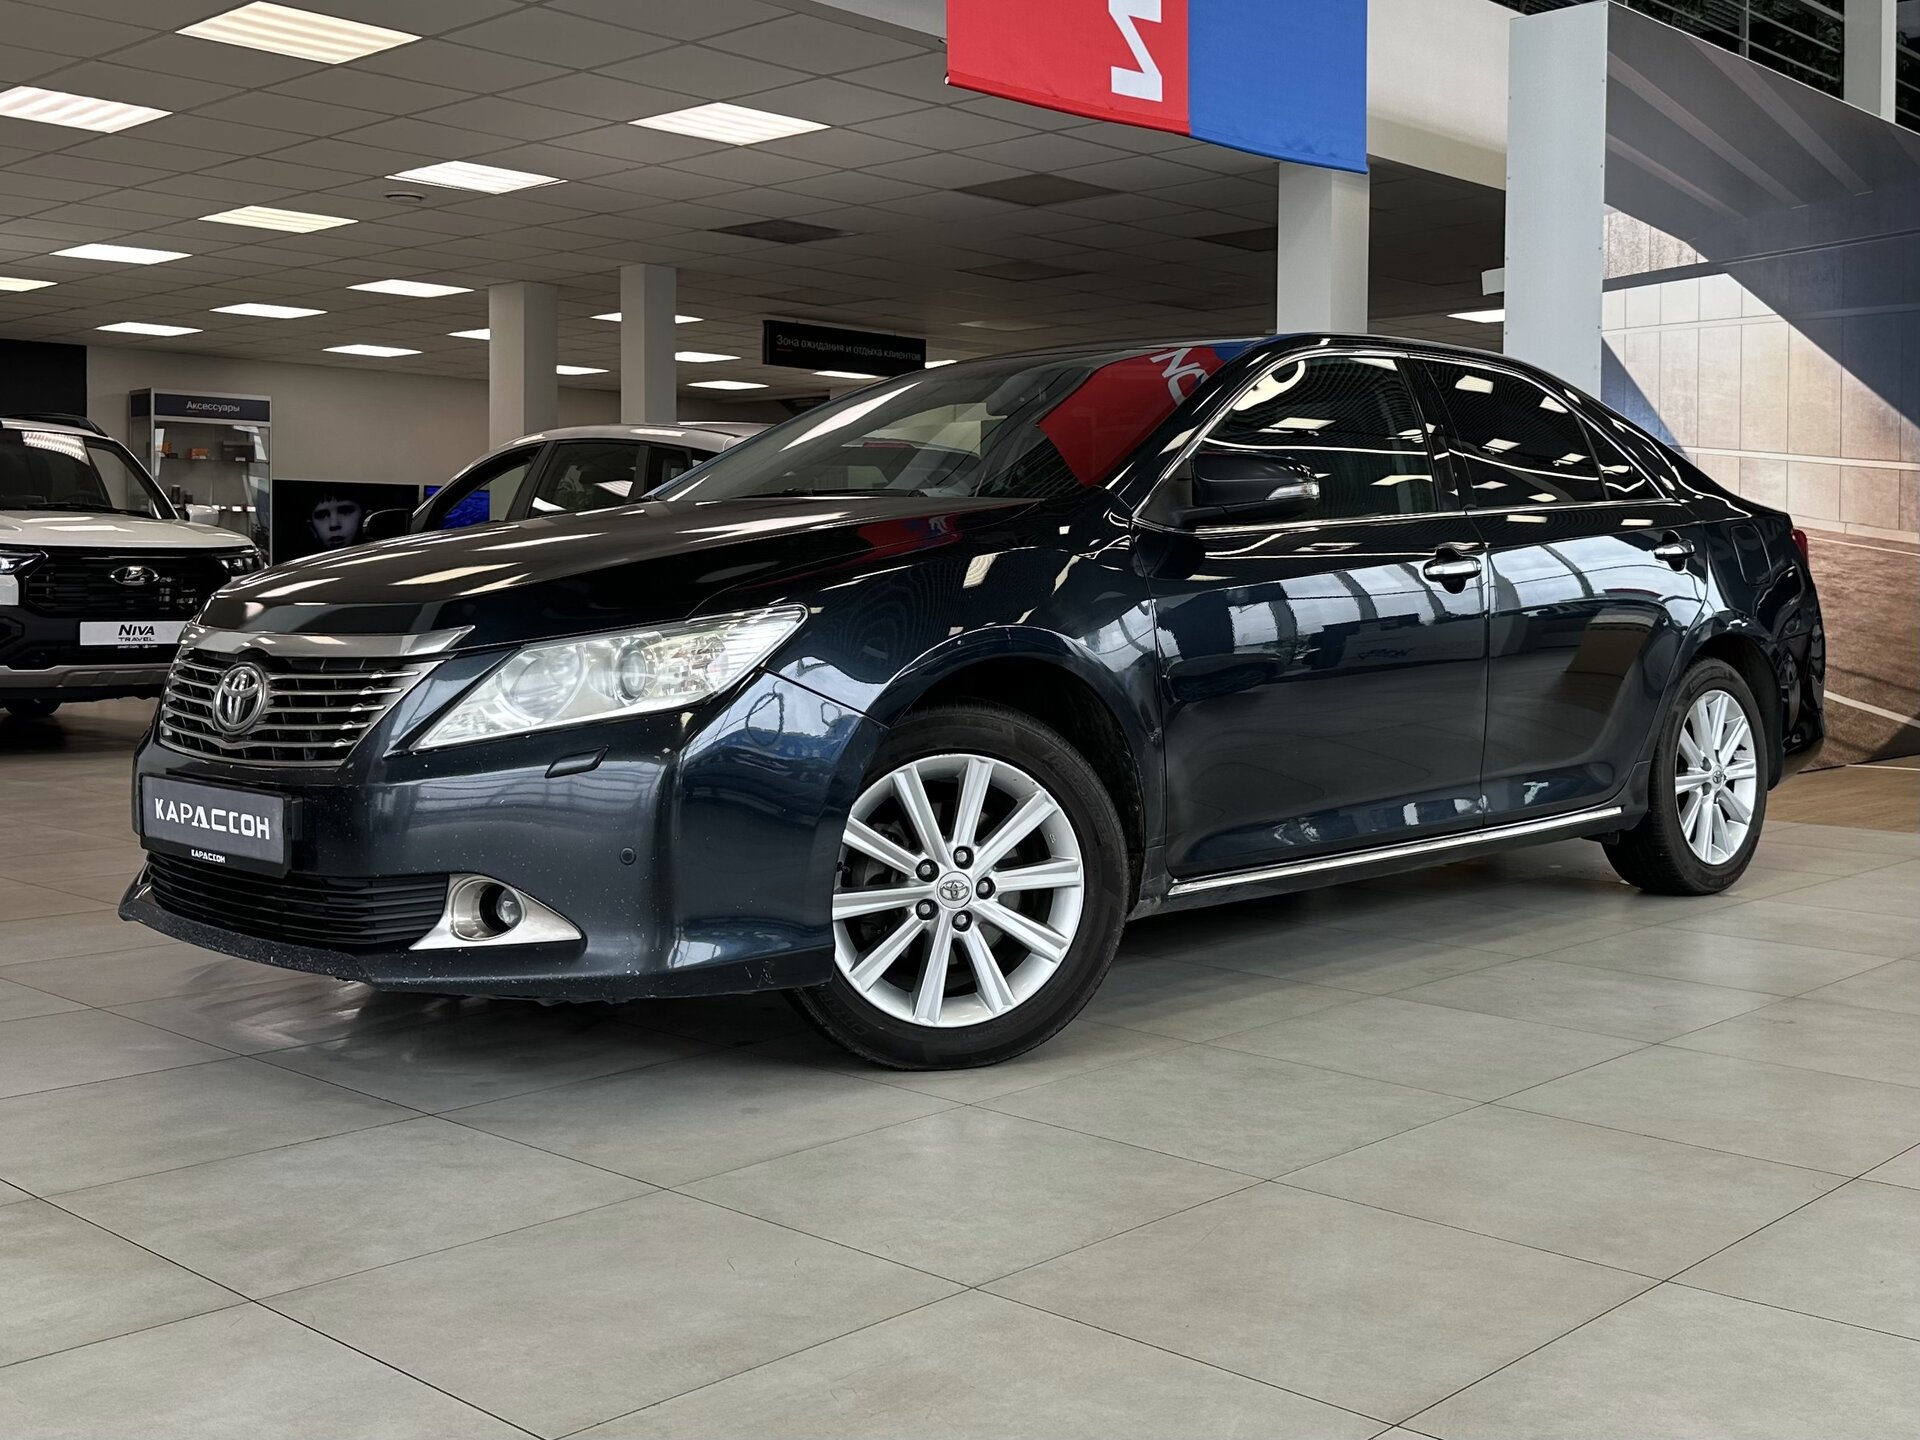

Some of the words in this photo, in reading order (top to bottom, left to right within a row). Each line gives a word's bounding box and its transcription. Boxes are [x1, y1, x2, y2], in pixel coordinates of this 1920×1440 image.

[776, 334, 799, 348] Зона
[801, 340, 845, 353] ожидания
[853, 346, 883, 357] отдыха
[884, 350, 922, 361] клиентов
[186, 400, 240, 413] Аксессуары
[154, 797, 270, 841] КАРАССОН
[191, 848, 226, 864] КАРАССОН
